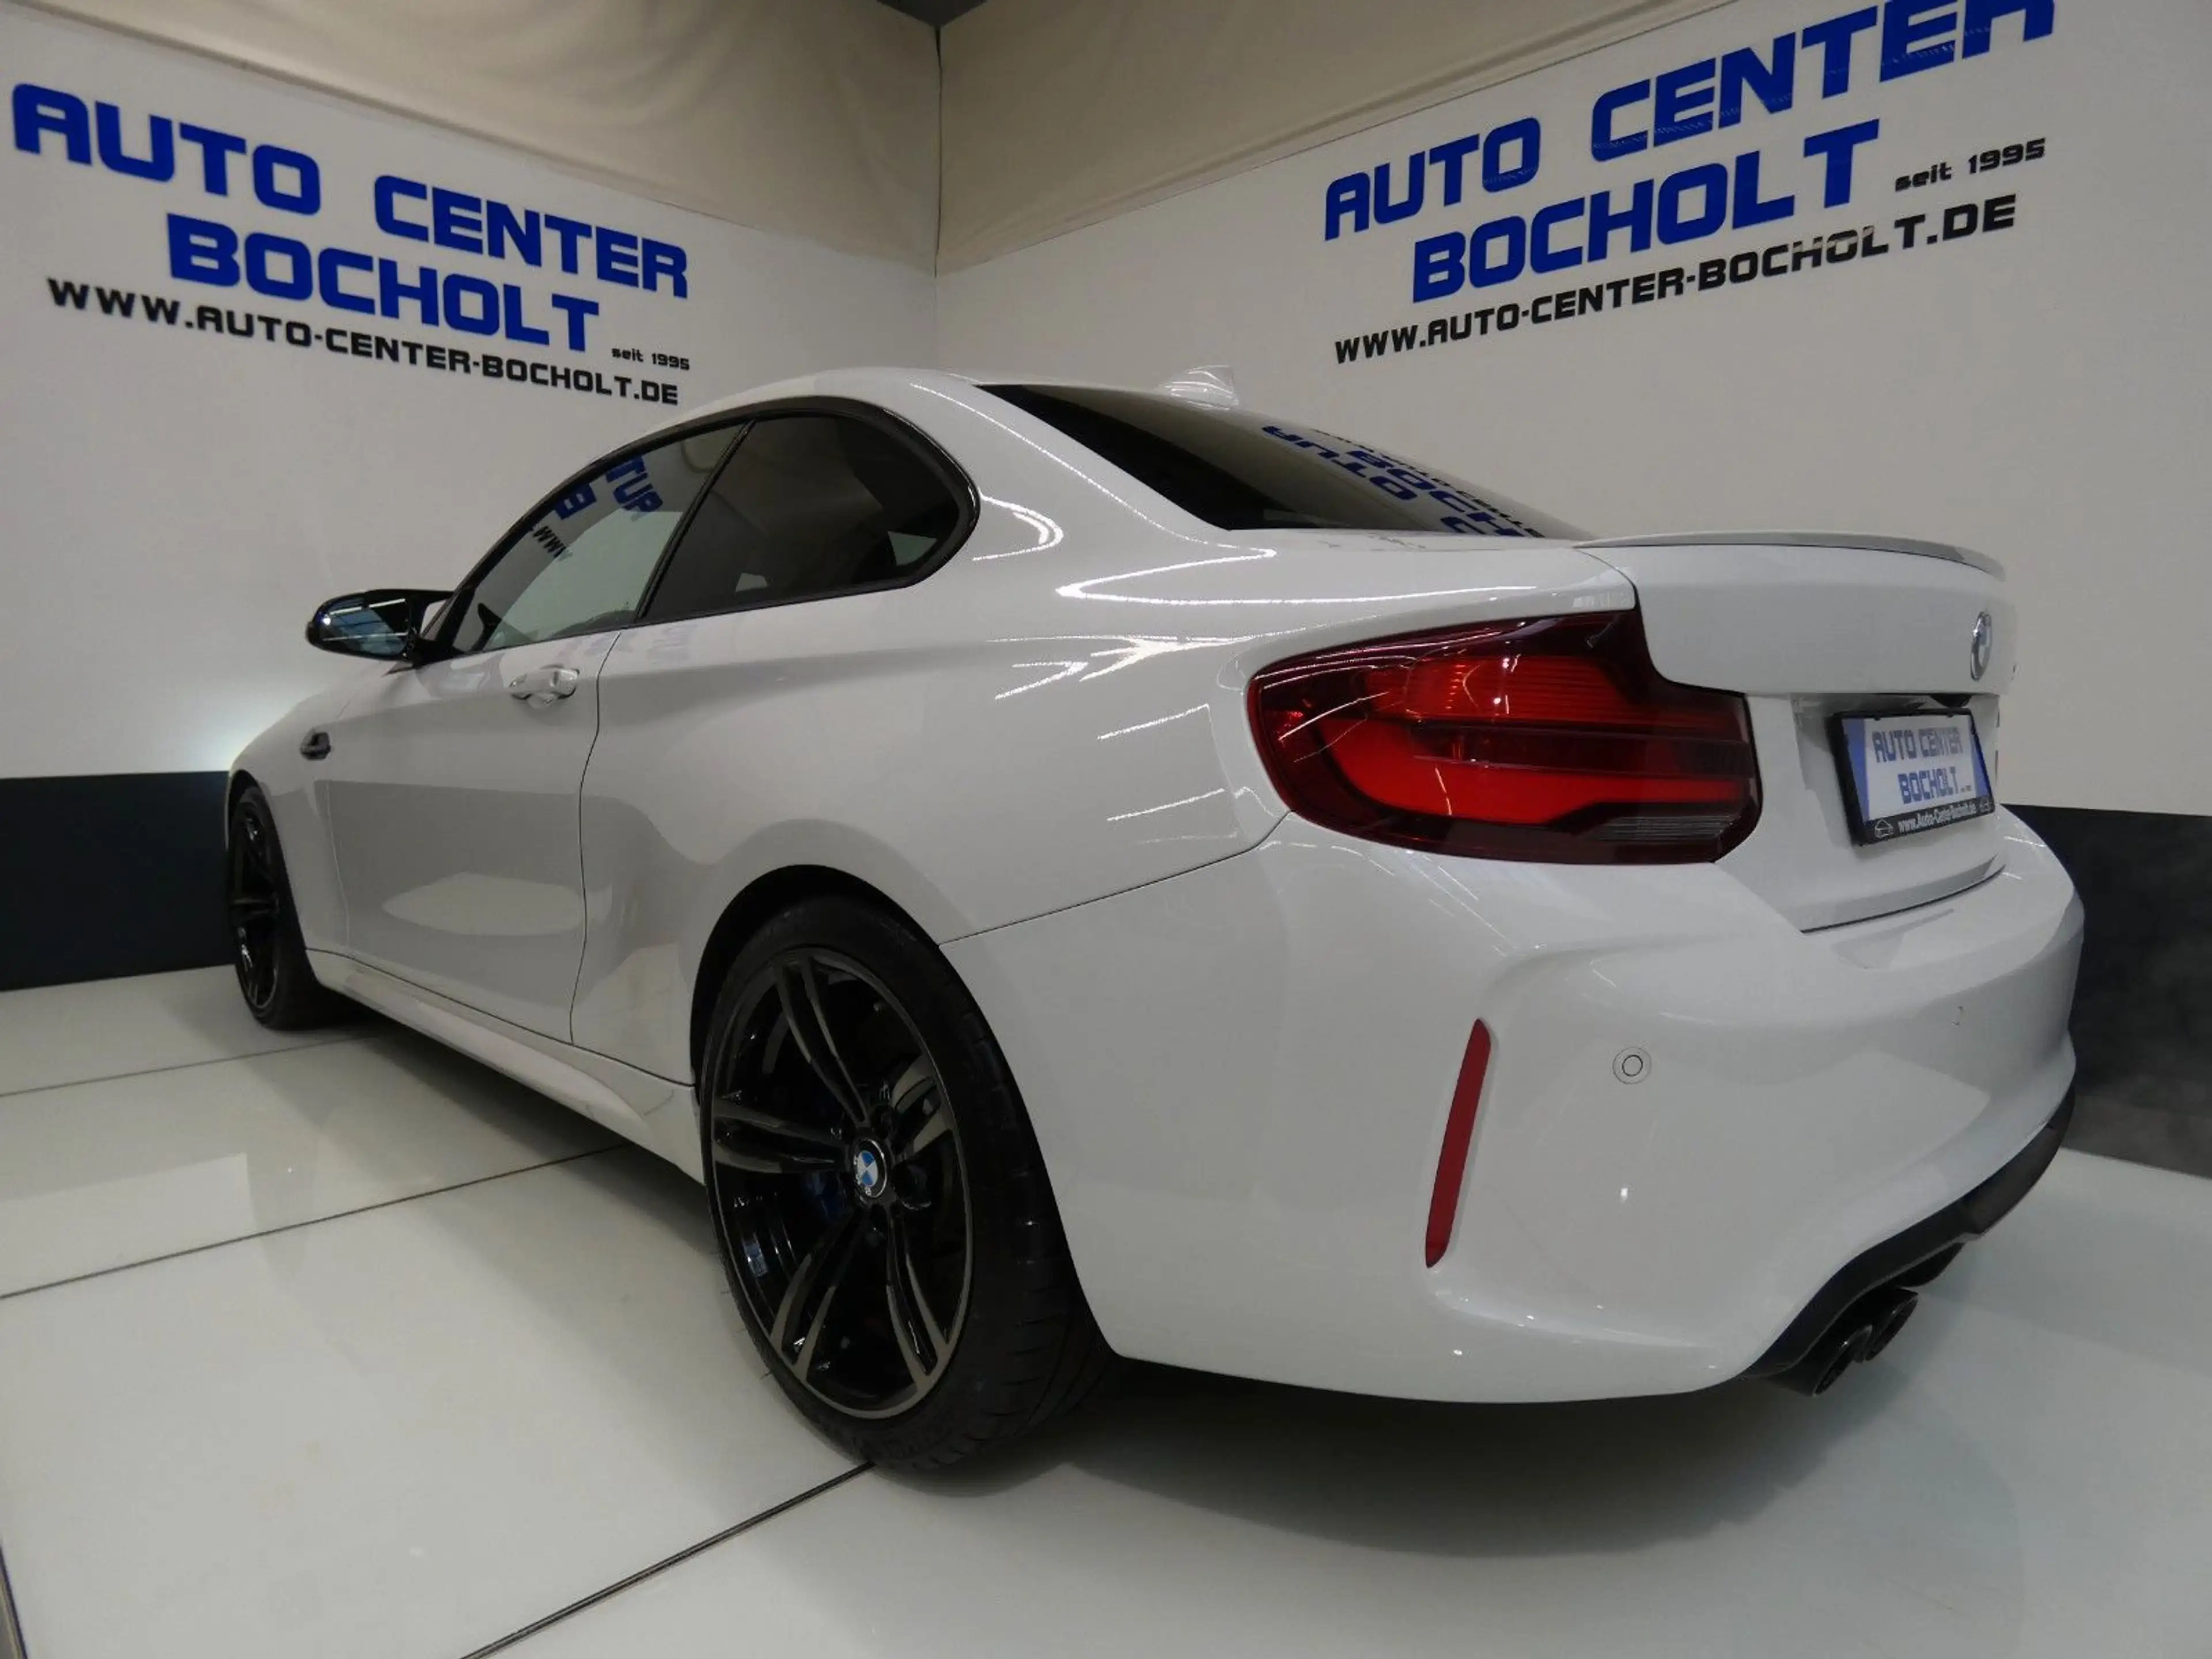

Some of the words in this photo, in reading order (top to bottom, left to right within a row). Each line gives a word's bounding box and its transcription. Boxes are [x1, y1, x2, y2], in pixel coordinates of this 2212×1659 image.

[12, 83, 322, 217] AUTO
[374, 176, 688, 300] CENTER
[1325, 118, 1541, 241] AUTO
[1413, 120, 1880, 302] BOCHOLT
[1895, 162, 1952, 192] seit
[1968, 138, 2046, 175] 1995
[167, 213, 600, 351] BOCHOLT
[611, 348, 644, 363] seit
[651, 353, 690, 370] 1995
[1872, 730, 1917, 763] AUTO
[1897, 767, 1959, 804] BOCHOLT
